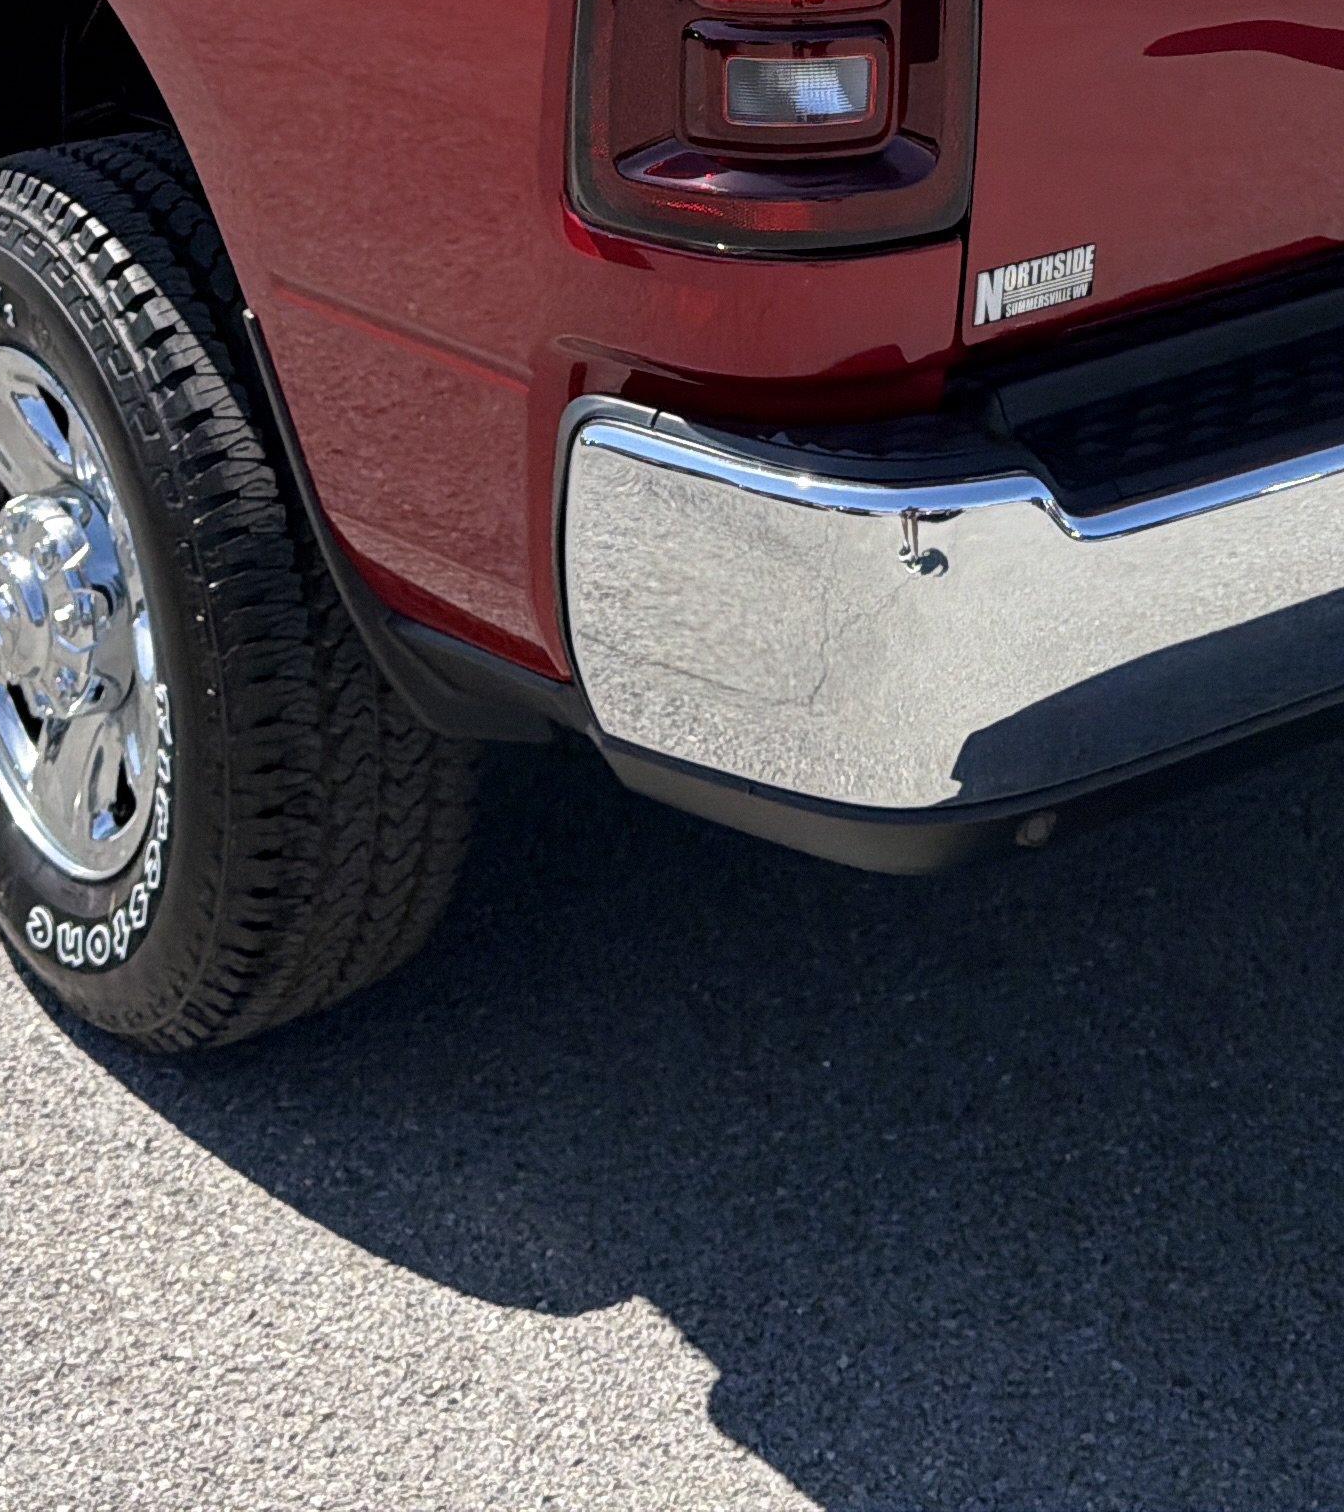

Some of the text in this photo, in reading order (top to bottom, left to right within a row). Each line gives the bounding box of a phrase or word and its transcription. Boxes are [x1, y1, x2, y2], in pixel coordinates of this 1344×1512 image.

[973, 243, 1096, 326] NORTHSIDE
[1005, 282, 1089, 319] SUMMERSVILLE WV
